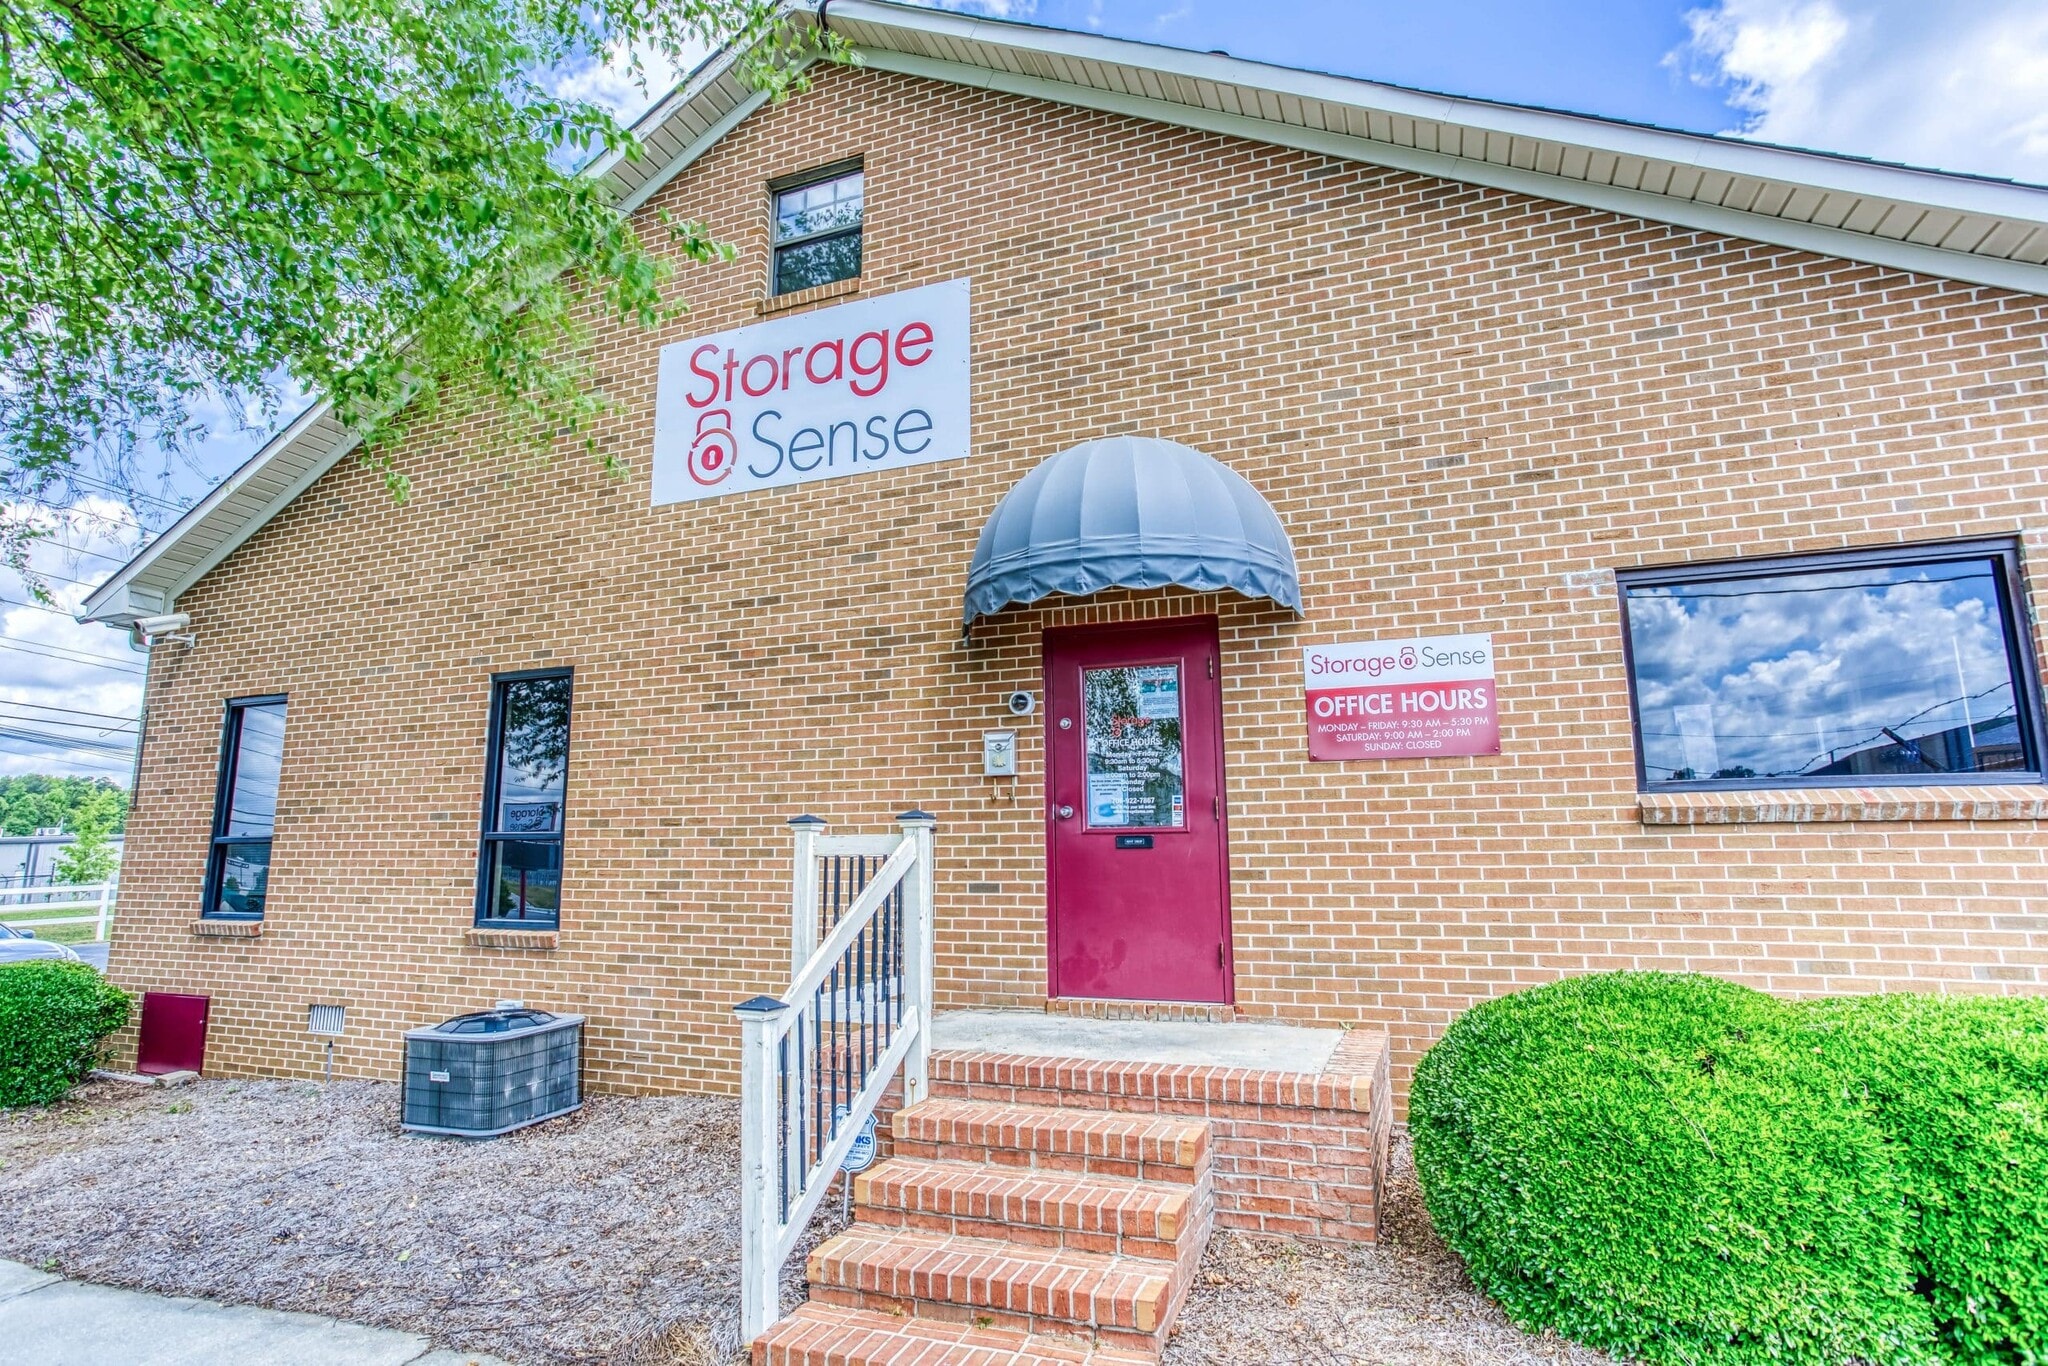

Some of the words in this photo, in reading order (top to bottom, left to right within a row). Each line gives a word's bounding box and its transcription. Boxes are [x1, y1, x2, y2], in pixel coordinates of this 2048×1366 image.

[685, 321, 934, 409] Storage
[748, 409, 933, 478] Sense
[1311, 654, 1395, 677] Storage
[1422, 646, 1486, 667] Sense
[1314, 692, 1393, 718] OFFICE
[1401, 687, 1488, 714] HOURS
[1317, 722, 1359, 733] MONDAY
[1368, 721, 1400, 731] FRIDAY:
[1401, 719, 1423, 729] 9:30
[1425, 719, 1441, 728] AM
[1450, 716, 1473, 727] 5:30
[1474, 716, 1490, 726] PM
[1336, 731, 1382, 743] SATURDAY:
[1384, 730, 1405, 740] 9:00
[1407, 730, 1423, 739] AM
[1432, 728, 1454, 738] 2:00
[1456, 728, 1471, 737] PM
[1102, 739, 1130, 748] OFFICE
[1364, 741, 1404, 752] SUNDAY:
[1405, 739, 1442, 750] CLOSED
